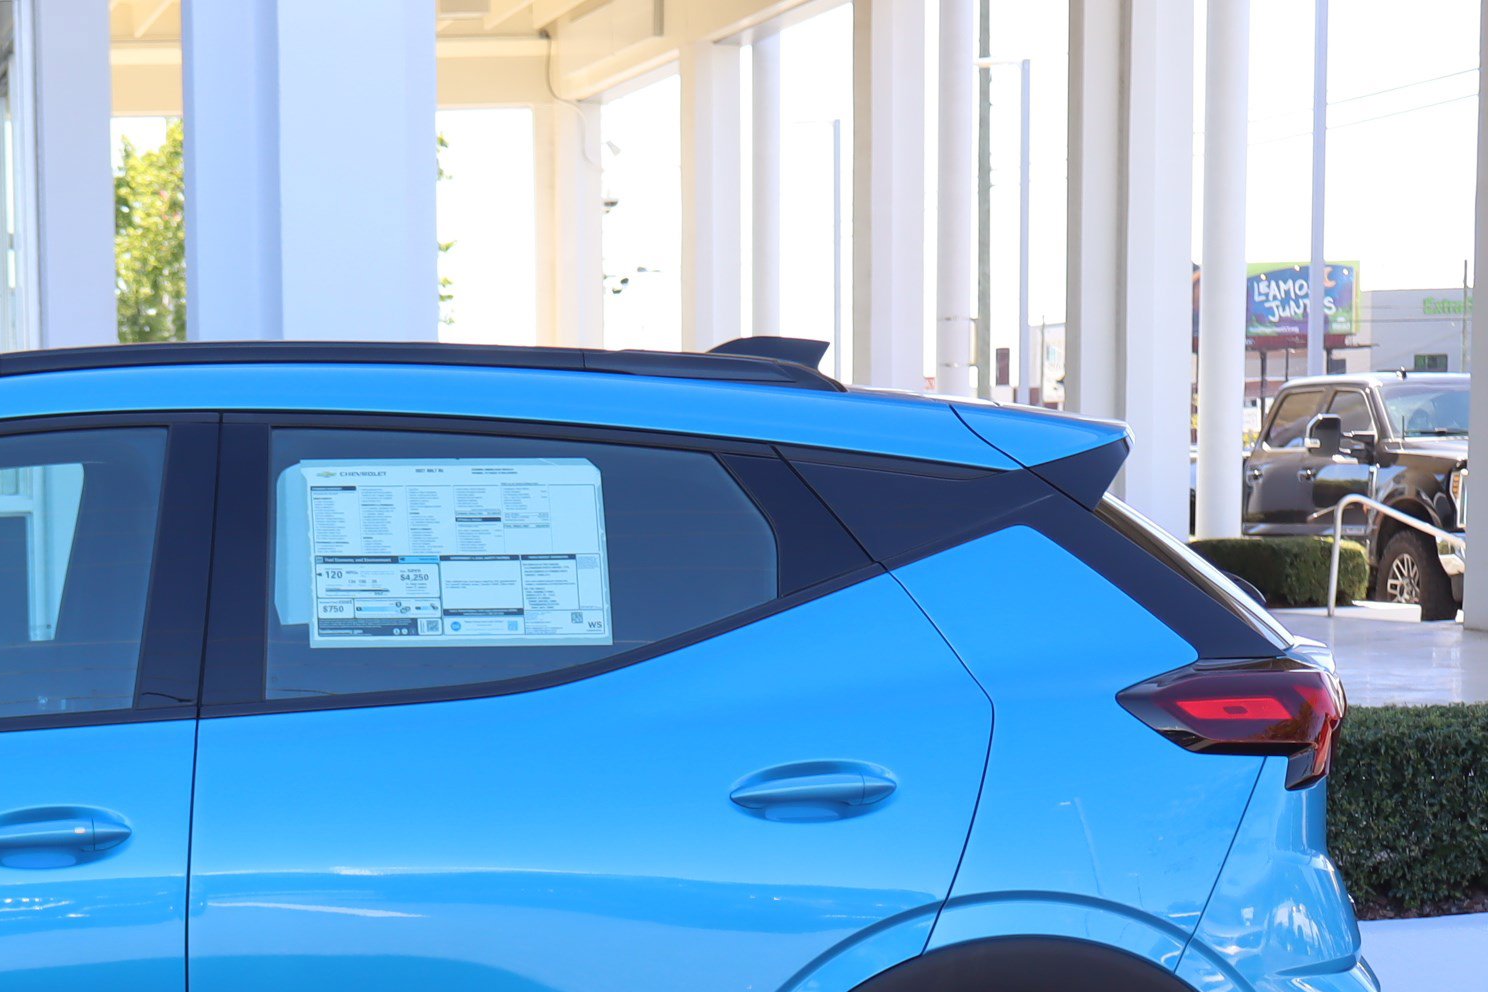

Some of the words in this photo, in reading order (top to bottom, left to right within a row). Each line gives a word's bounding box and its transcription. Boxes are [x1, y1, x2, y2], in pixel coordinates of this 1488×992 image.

[1253, 279, 1310, 302] LEAMO
[1264, 297, 1336, 323] JUNTS
[325, 571, 343, 579] 120
[401, 574, 429, 582] $4,250
[322, 605, 344, 613] $750
[587, 620, 602, 628] WS
